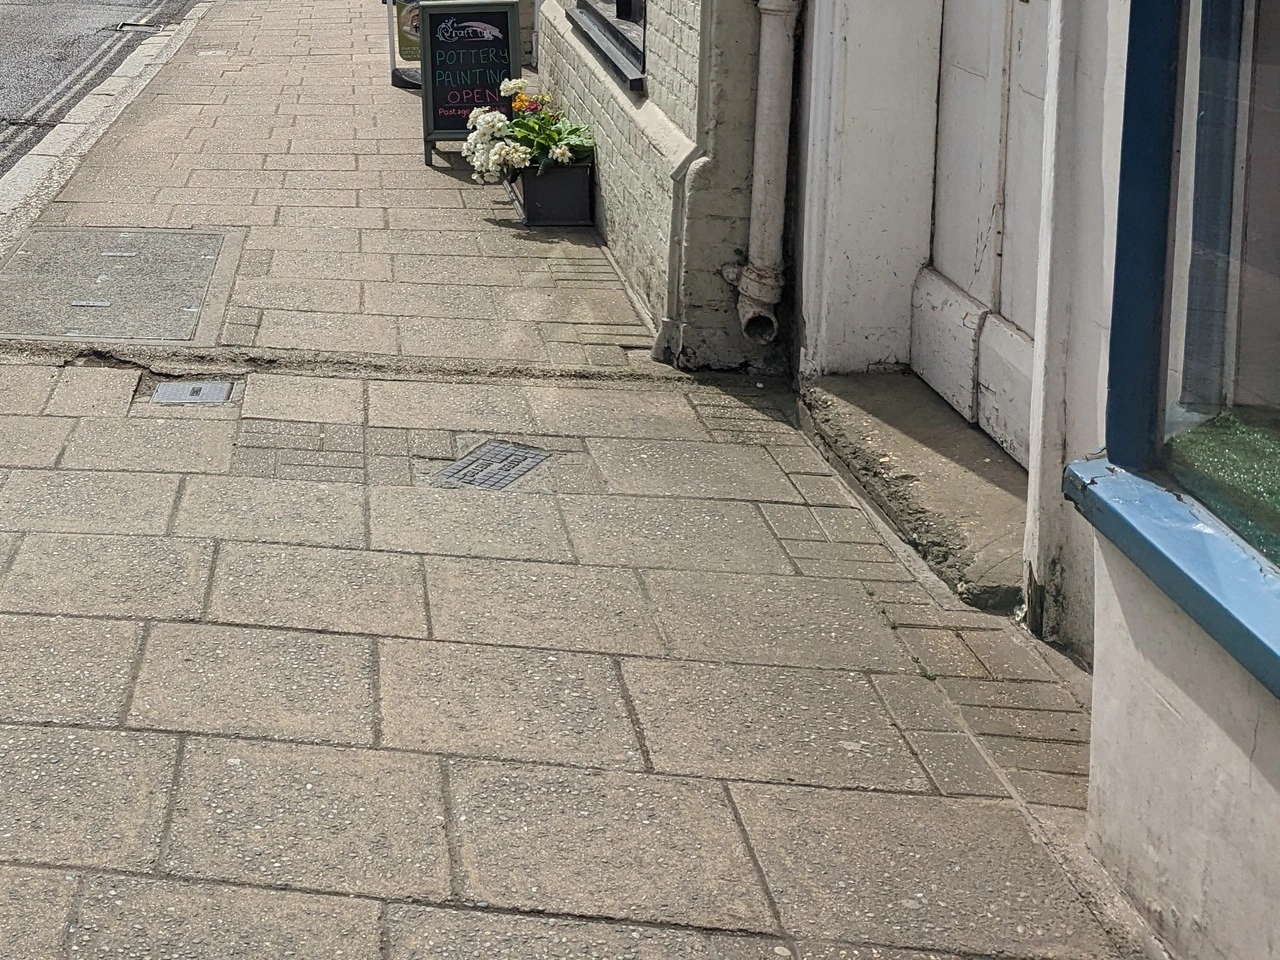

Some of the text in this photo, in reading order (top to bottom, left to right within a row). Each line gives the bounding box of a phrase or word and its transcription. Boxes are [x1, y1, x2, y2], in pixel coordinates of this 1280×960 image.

[436, 48, 510, 66] POTTERY
[447, 89, 499, 104] OPEN
[438, 107, 470, 118] Postage
